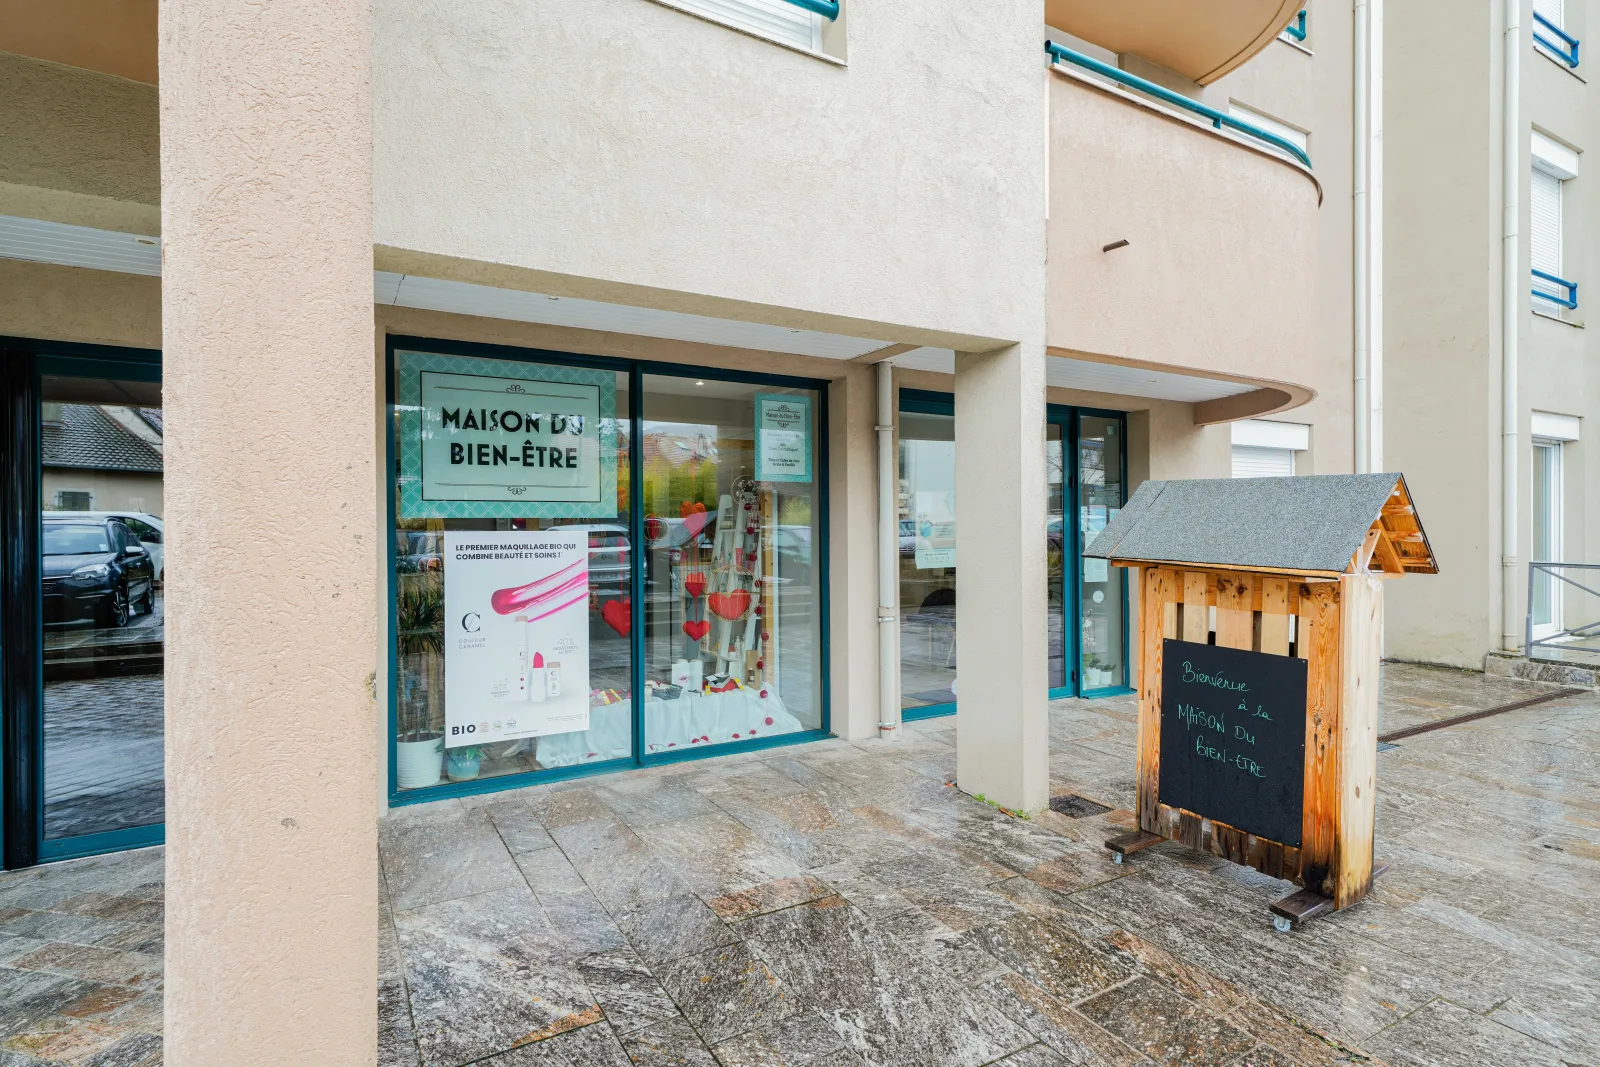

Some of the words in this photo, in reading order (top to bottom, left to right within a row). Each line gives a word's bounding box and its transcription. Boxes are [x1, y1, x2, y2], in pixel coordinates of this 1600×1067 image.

[441, 406, 540, 434] MAISON
[551, 414, 583, 436] DU
[450, 439, 578, 469] BIEN-ÊTRE
[456, 552, 494, 560] COMBINE
[494, 550, 524, 560] BEAUTÉ
[500, 543, 549, 552] MAQUILLAGE
[1182, 660, 1250, 692] Bienvenue
[1237, 698, 1249, 711] à
[1251, 705, 1274, 721] la
[451, 724, 477, 736] BIO
